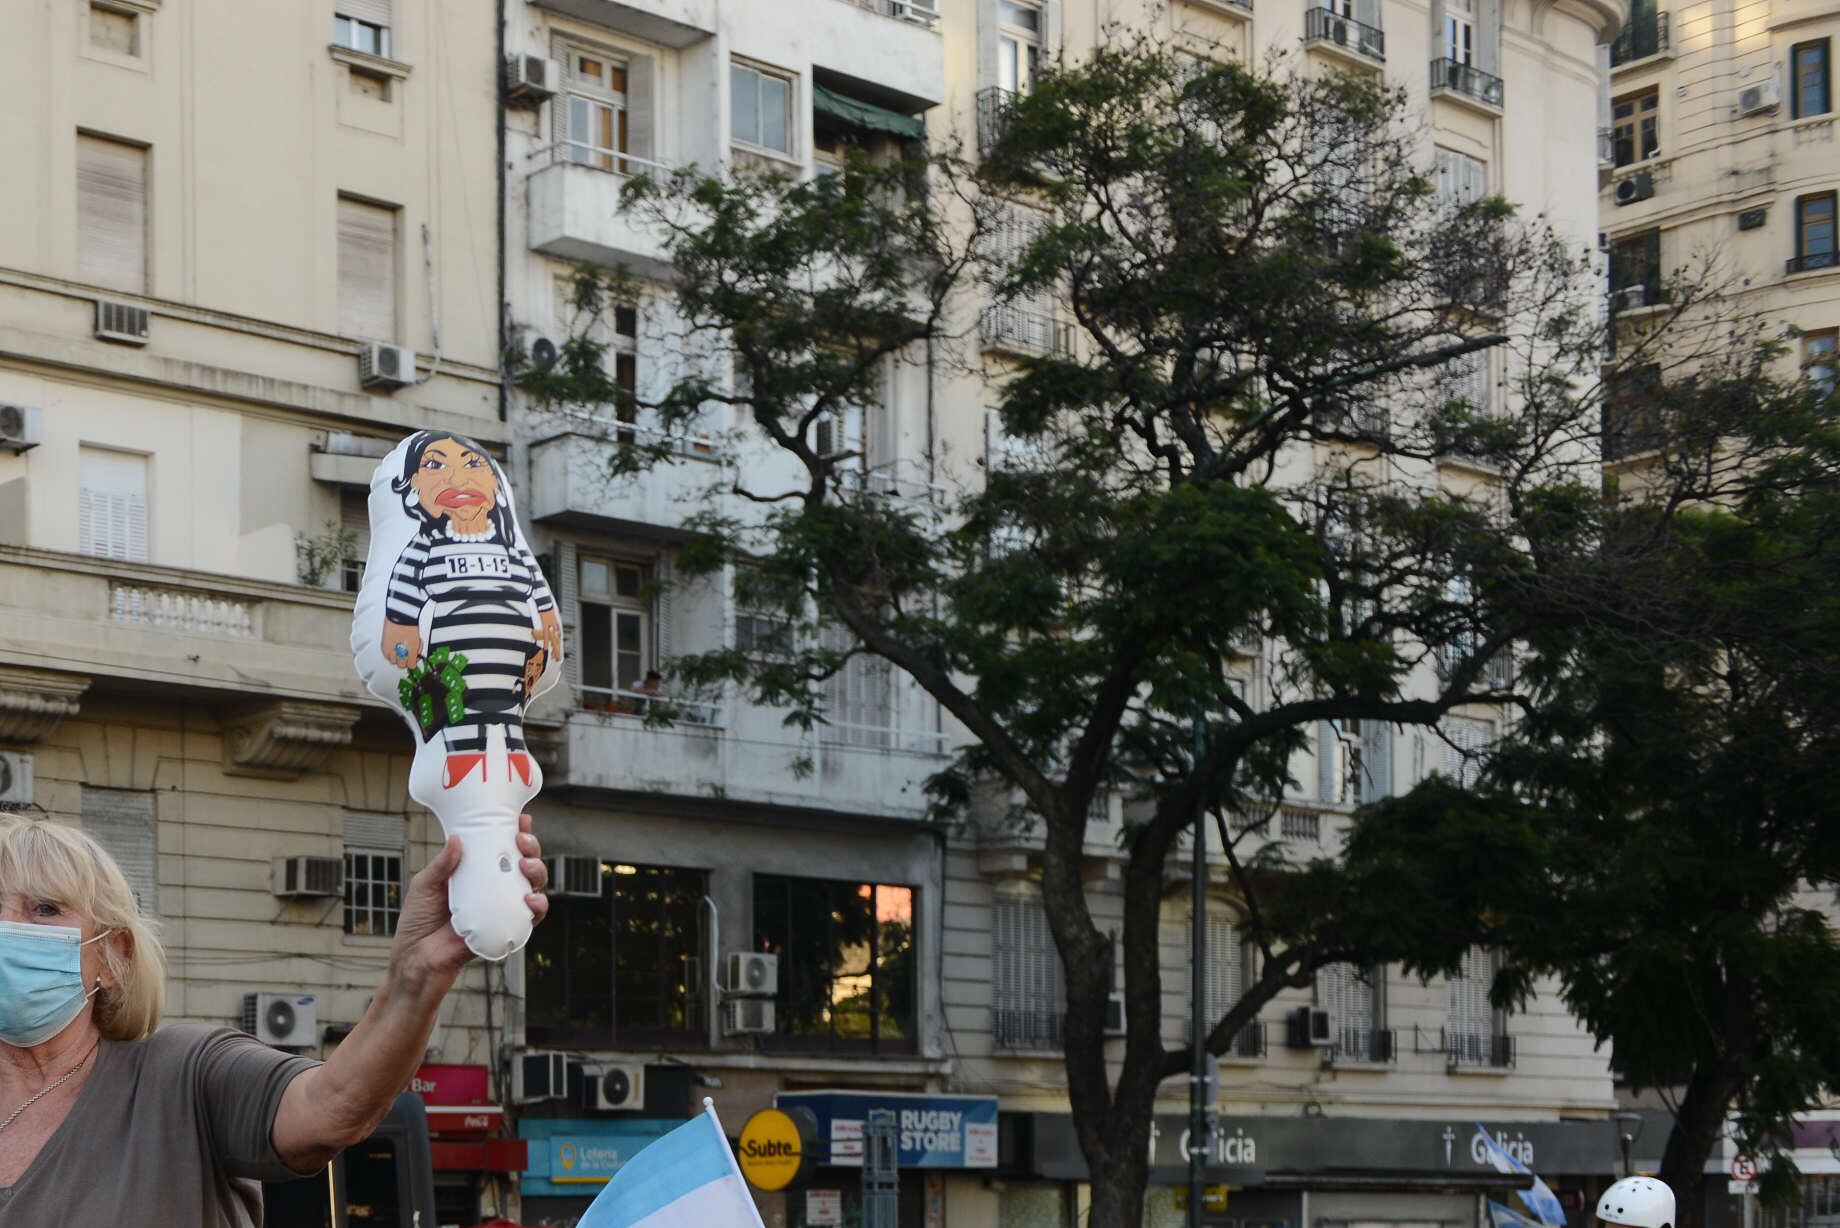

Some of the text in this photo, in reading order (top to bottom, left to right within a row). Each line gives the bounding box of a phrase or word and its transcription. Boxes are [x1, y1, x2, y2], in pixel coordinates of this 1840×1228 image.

[448, 557, 508, 574] 18-1-15
[411, 1078, 437, 1093] Bar
[900, 1110, 962, 1131] RUGBY
[747, 1140, 793, 1157] Subte
[900, 1131, 961, 1151] STORE
[1180, 1127, 1256, 1164] Gicia
